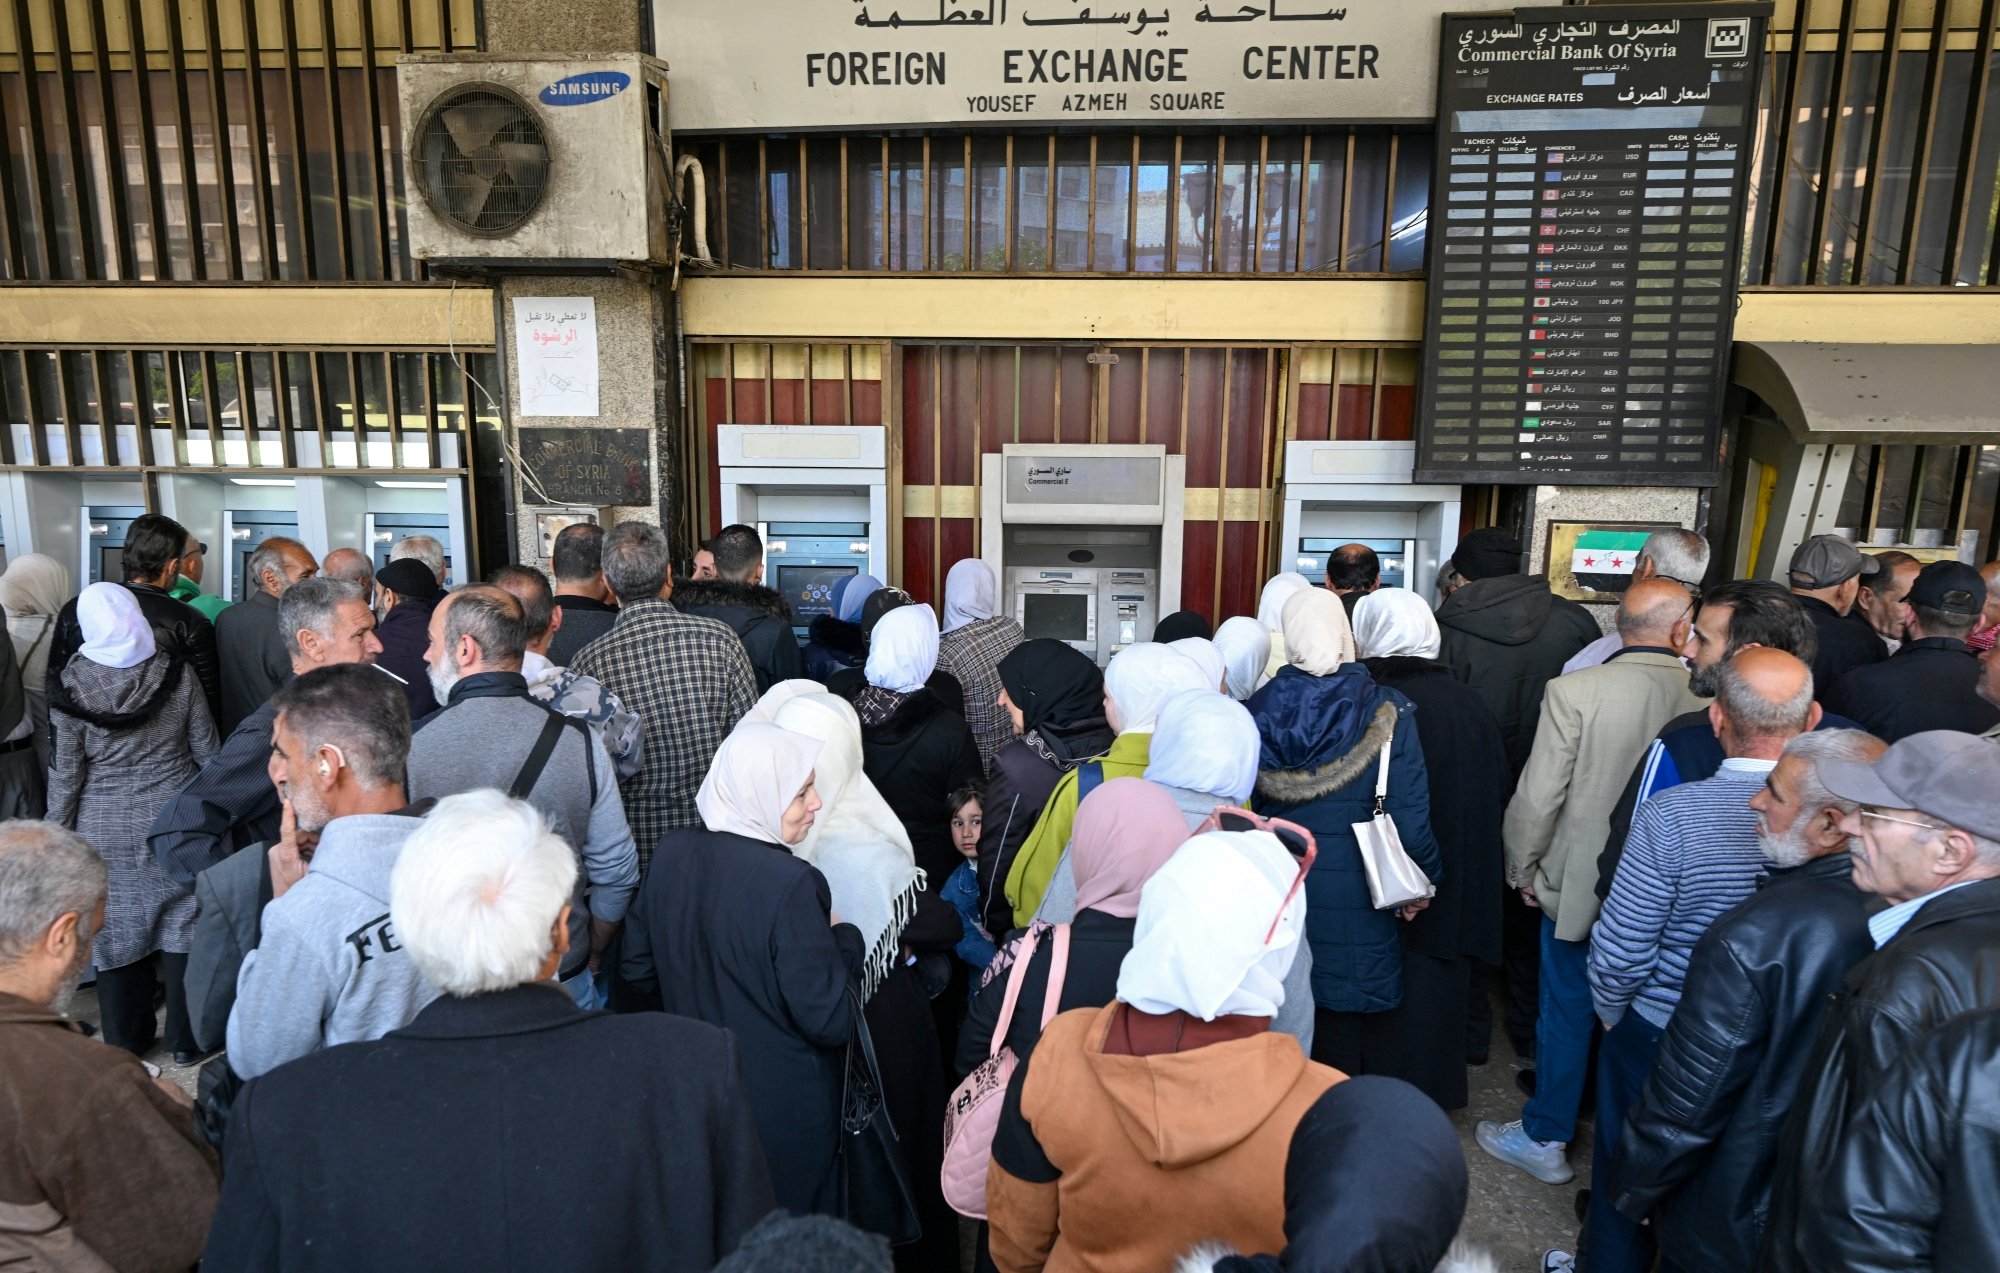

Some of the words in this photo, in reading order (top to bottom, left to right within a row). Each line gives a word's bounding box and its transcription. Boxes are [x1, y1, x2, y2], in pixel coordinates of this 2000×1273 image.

[1458, 23, 1523, 48] السوري
[1533, 21, 1597, 46] التجاري
[1608, 19, 1680, 40] المصرف
[1458, 45, 1556, 62] Commercial
[1560, 44, 1603, 60] Bank
[1608, 43, 1631, 59] Of
[1633, 42, 1677, 62] Syria
[806, 52, 946, 88] FOREIGN
[1004, 48, 1188, 84] EXCHANGE
[1242, 44, 1380, 81] CENTER
[549, 82, 621, 96] SAMSUNG
[1486, 93, 1546, 104] EXCHANGE
[1547, 92, 1584, 102] RATES
[1617, 86, 1667, 105] الصرف
[1671, 83, 1712, 104] أسعار
[966, 94, 1037, 113] YOUSEF
[1062, 92, 1127, 112] AZMEH
[1150, 91, 1226, 111] SQUARE
[544, 312, 555, 322] ولا
[579, 312, 587, 320] لا
[533, 327, 578, 346] الرشوة
[528, 439, 601, 471] COMMERCIAL
[558, 464, 573, 479] OF
[576, 464, 612, 480] SYRIA
[1028, 477, 1064, 485] Commercial
[547, 484, 592, 496] BRANCH
